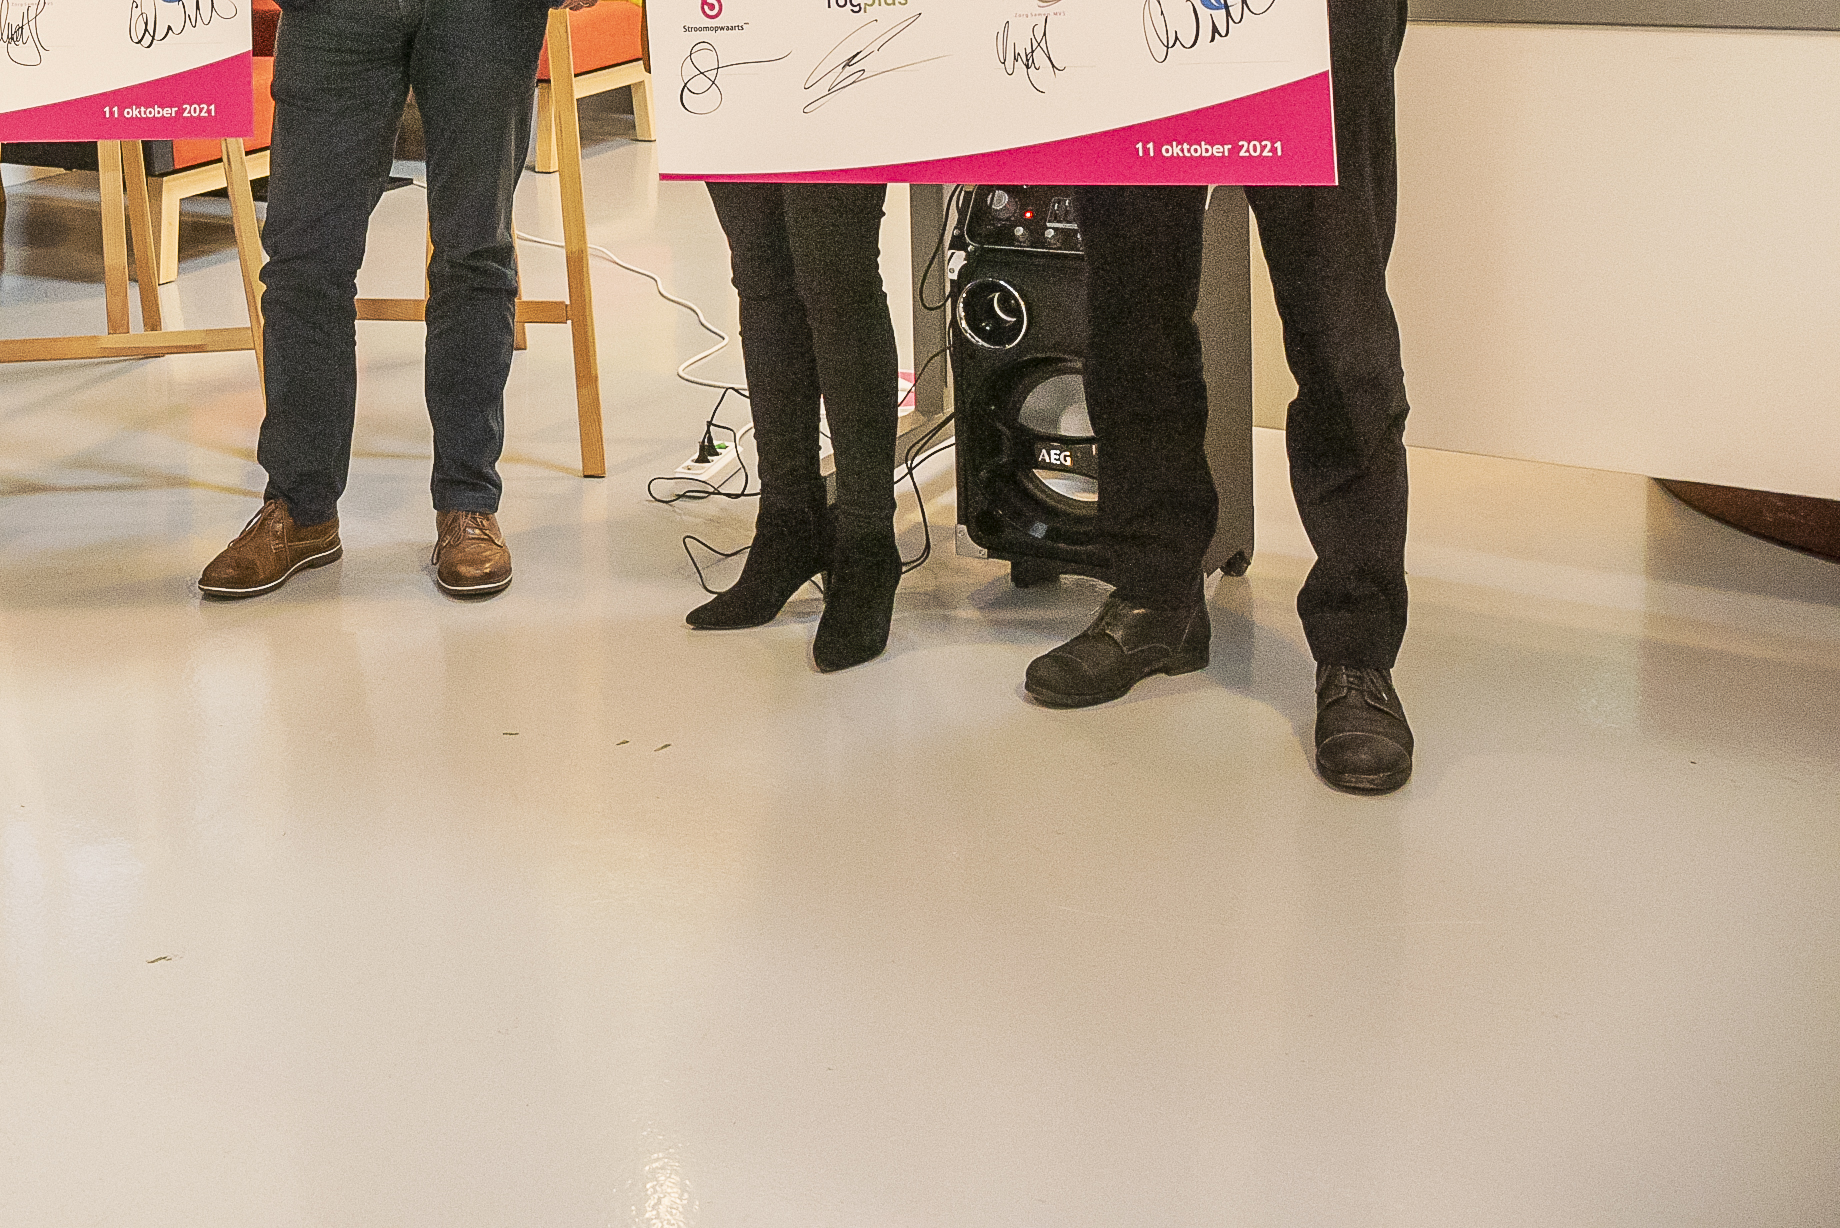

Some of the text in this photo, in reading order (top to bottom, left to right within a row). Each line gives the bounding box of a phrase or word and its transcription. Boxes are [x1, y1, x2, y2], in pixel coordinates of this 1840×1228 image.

[682, 24, 745, 34] Stroomopwaarts
[104, 104, 215, 117] 11 oktober 2021
[1136, 141, 1281, 156] 11 oktober 2021
[1038, 449, 1073, 466] AEG
